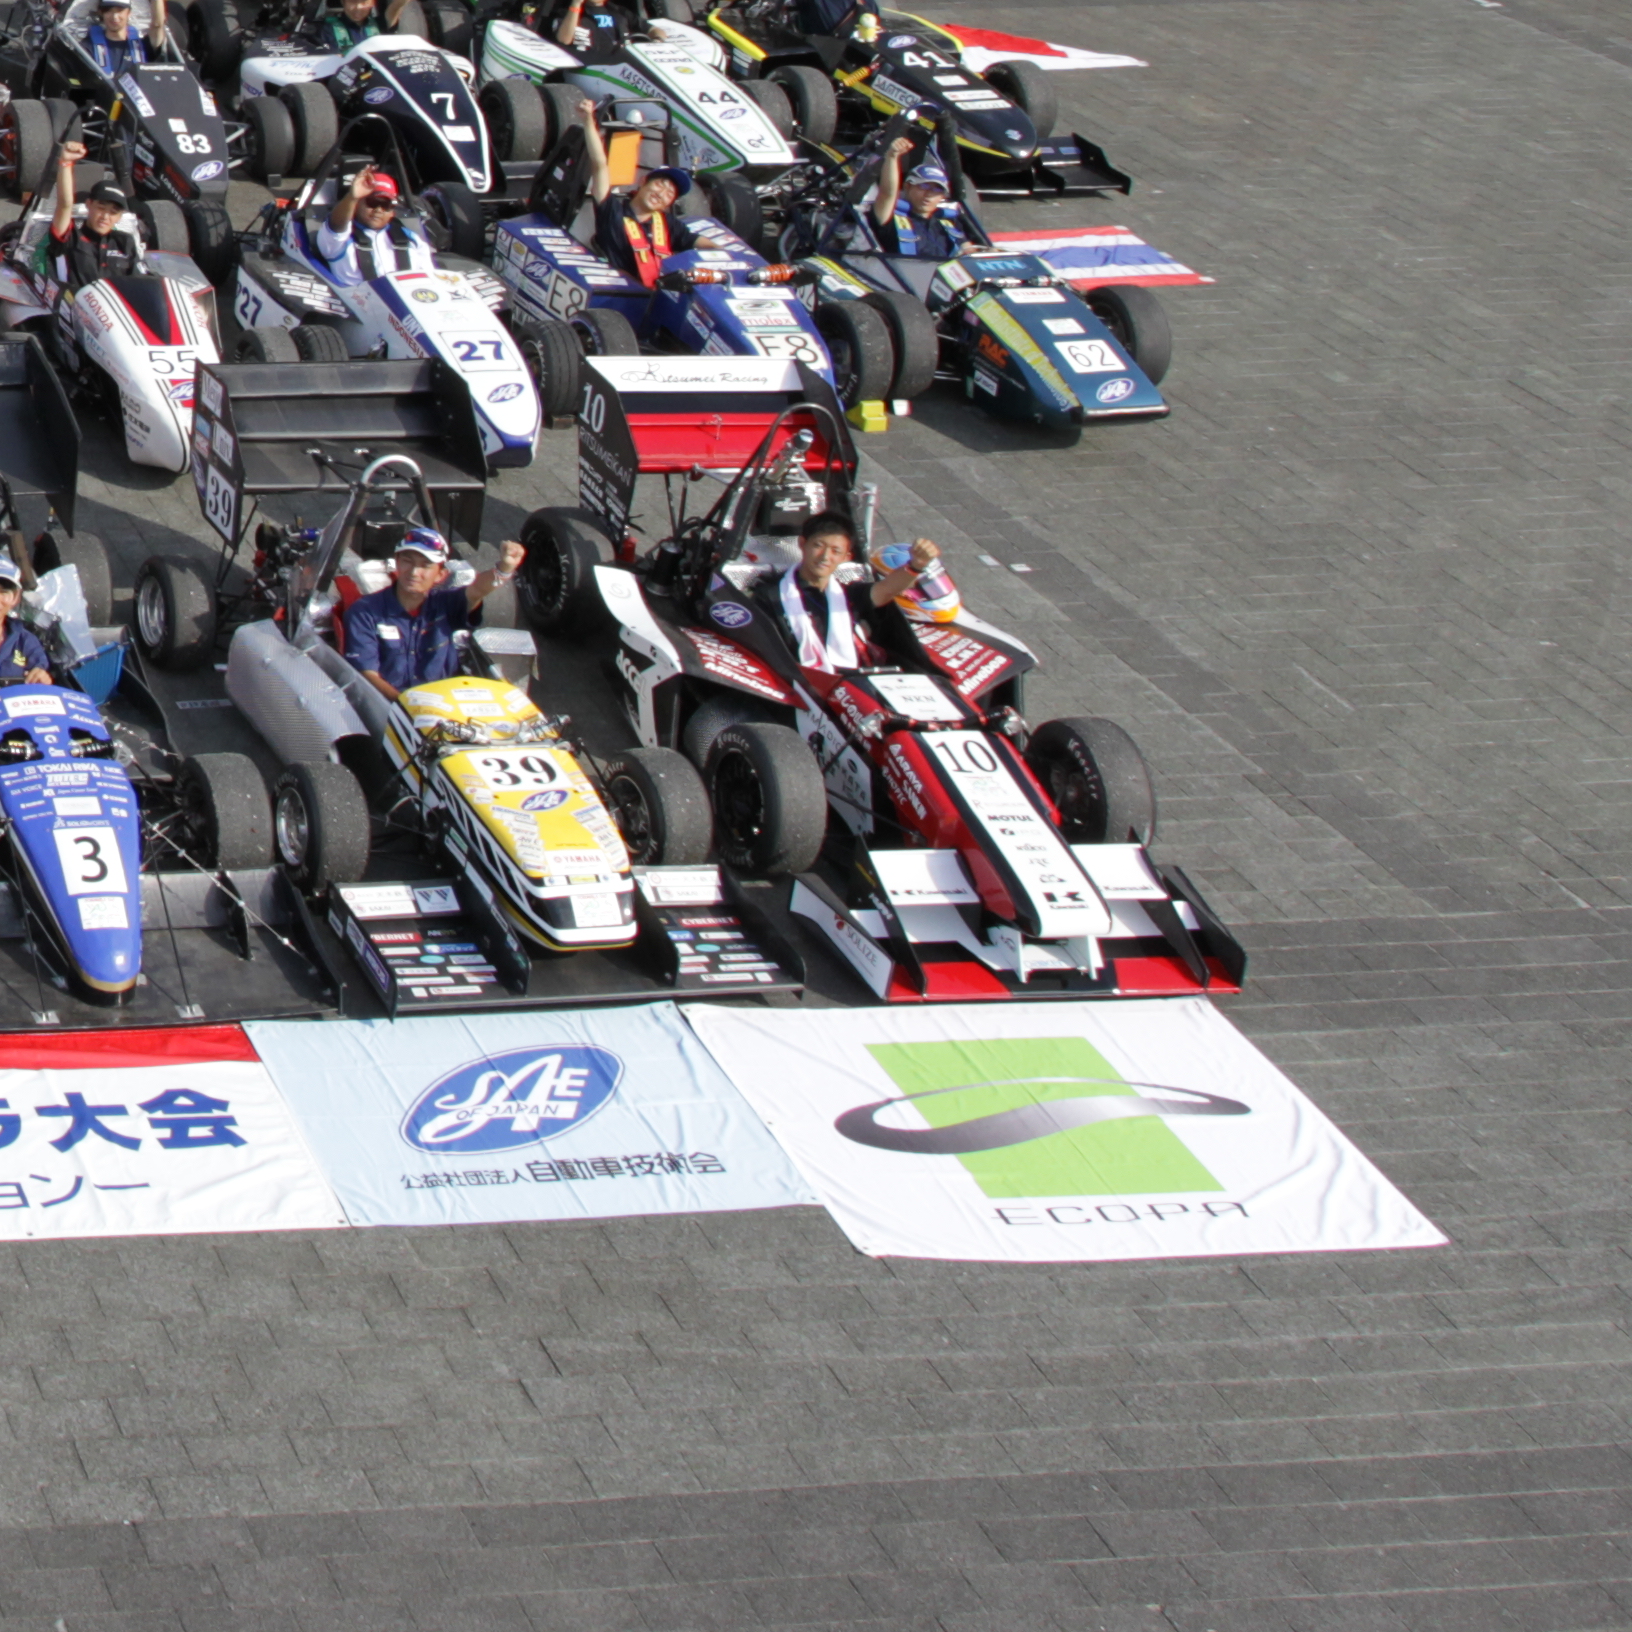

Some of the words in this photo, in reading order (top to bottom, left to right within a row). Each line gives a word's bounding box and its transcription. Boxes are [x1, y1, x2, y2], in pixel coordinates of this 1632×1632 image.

[902, 51, 955, 69] 41
[430, 92, 456, 121] 7
[697, 90, 739, 105] 44
[176, 133, 211, 155] 83
[978, 259, 1024, 272] NTN
[548, 273, 588, 319] E8
[83, 290, 115, 333] HONDA
[741, 316, 793, 326] molex
[386, 313, 426, 359] INDONESIA
[451, 339, 505, 363] 27
[1073, 345, 1116, 367] 62
[719, 372, 769, 388] Racing
[579, 383, 607, 433] 10
[579, 425, 632, 487] RITSUMEIKAN
[207, 465, 235, 525] 39
[703, 660, 787, 701] Minebea
[958, 654, 1008, 695] Minebea
[479, 753, 558, 786] 39
[937, 737, 999, 775] 10
[986, 814, 1035, 823] MOTUL
[73, 834, 109, 883] 3
[916, 886, 969, 897] Kawasaki
[1102, 883, 1156, 894] Kawasaki
[455, 1106, 478, 1121] OF
[486, 1103, 561, 1120] JAPAN
[990, 1200, 1252, 1227] ECOPA
